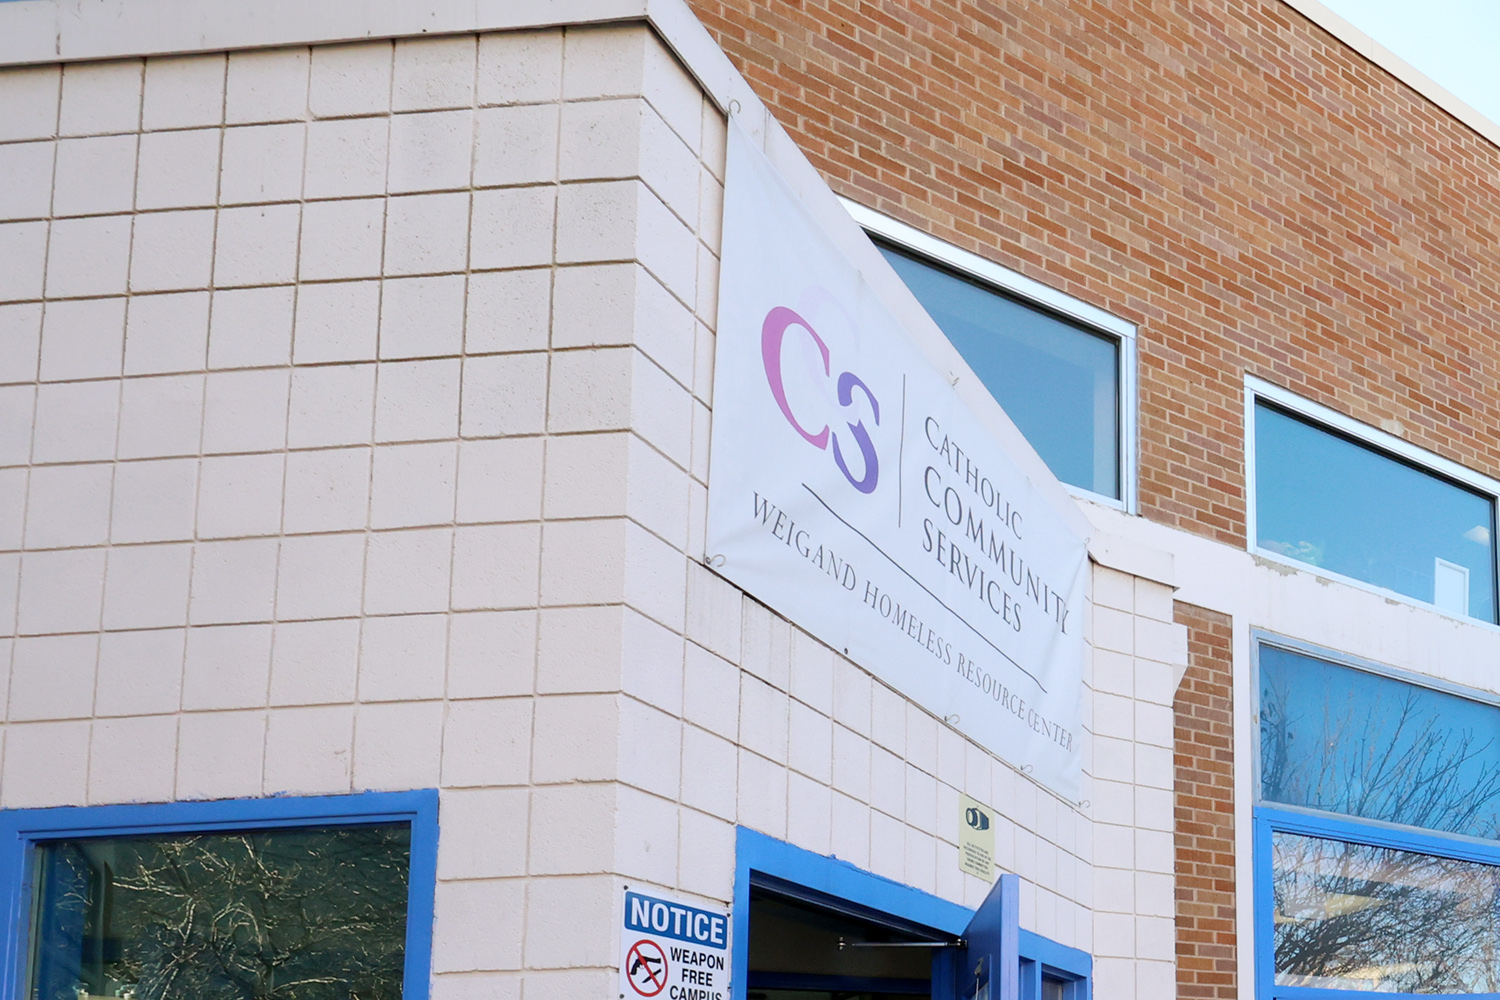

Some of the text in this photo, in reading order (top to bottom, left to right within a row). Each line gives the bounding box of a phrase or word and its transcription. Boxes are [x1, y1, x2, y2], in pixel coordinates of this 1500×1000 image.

[924, 416, 1024, 541] CATHOLIC
[922, 518, 1023, 634] SERVICES
[923, 465, 1070, 636] COMMUNITY
[751, 491, 1073, 754] WEIGAND HOMELESS RESOURCE CENTER
[630, 897, 724, 945] NOTICE
[670, 946, 725, 971] WEAPON
[681, 968, 713, 987] FREE
